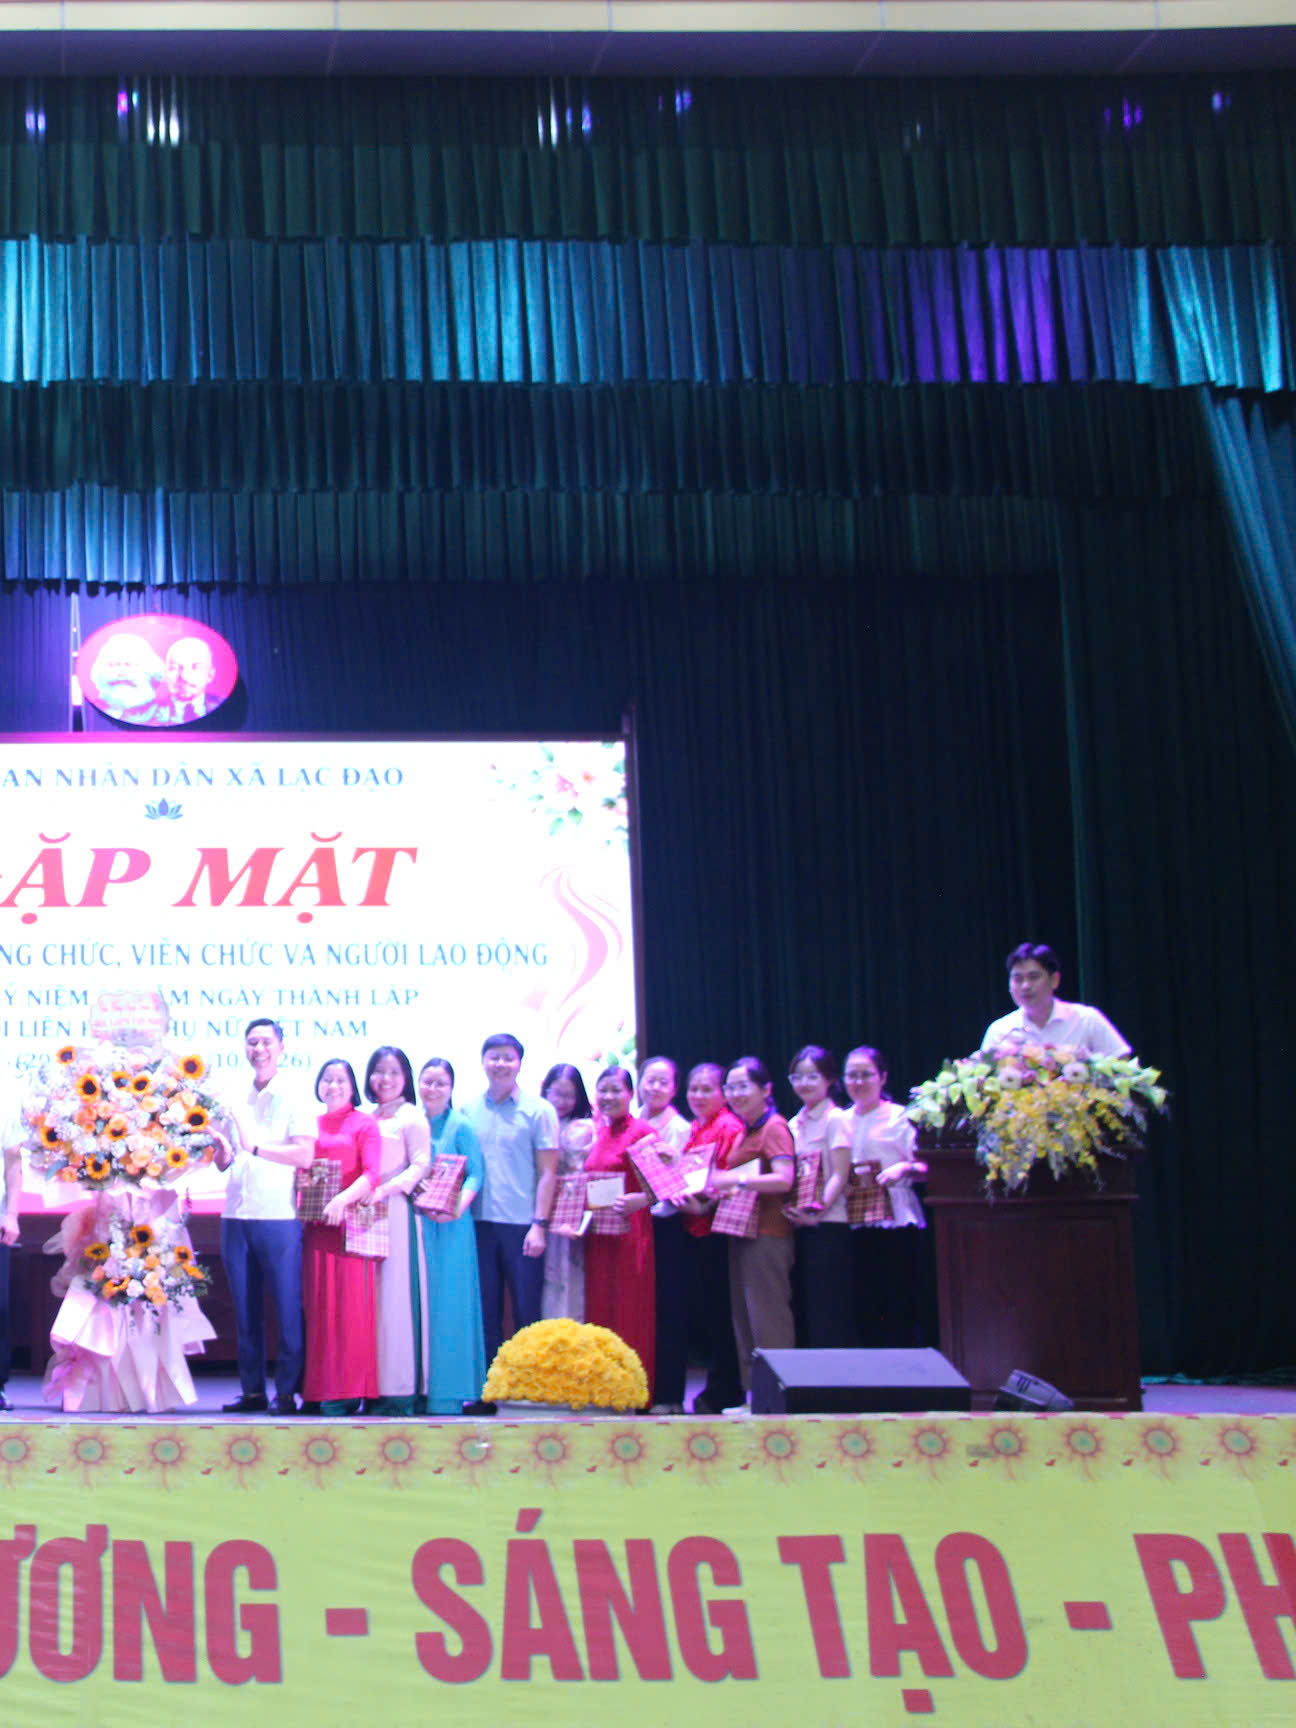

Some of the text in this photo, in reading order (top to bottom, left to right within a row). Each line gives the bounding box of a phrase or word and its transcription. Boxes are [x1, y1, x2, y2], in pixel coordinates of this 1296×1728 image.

[55, 761, 140, 788] NHÂN
[152, 761, 214, 787] DÂN
[227, 760, 267, 787] XÃ
[278, 767, 332, 792] LẠC
[342, 767, 404, 792] ĐẠO
[170, 831, 419, 924] MẶT
[42, 937, 121, 968] CHỨC,
[131, 937, 191, 967] VIÊN
[201, 937, 273, 967] CHỨC
[284, 937, 317, 967] VÀ
[326, 936, 408, 967] NGƯỜI
[419, 943, 467, 967] LAO
[476, 937, 549, 972] ĐỘNG
[19, 1016, 71, 1038] LIÊN
[207, 1016, 244, 1038] NỮ
[313, 1020, 368, 1038] NAM
[325, 1607, 369, 1636] -
[410, 1508, 759, 1684] SÁNG
[777, 1531, 1030, 1714] TẠO
[1063, 1601, 1113, 1631] -
